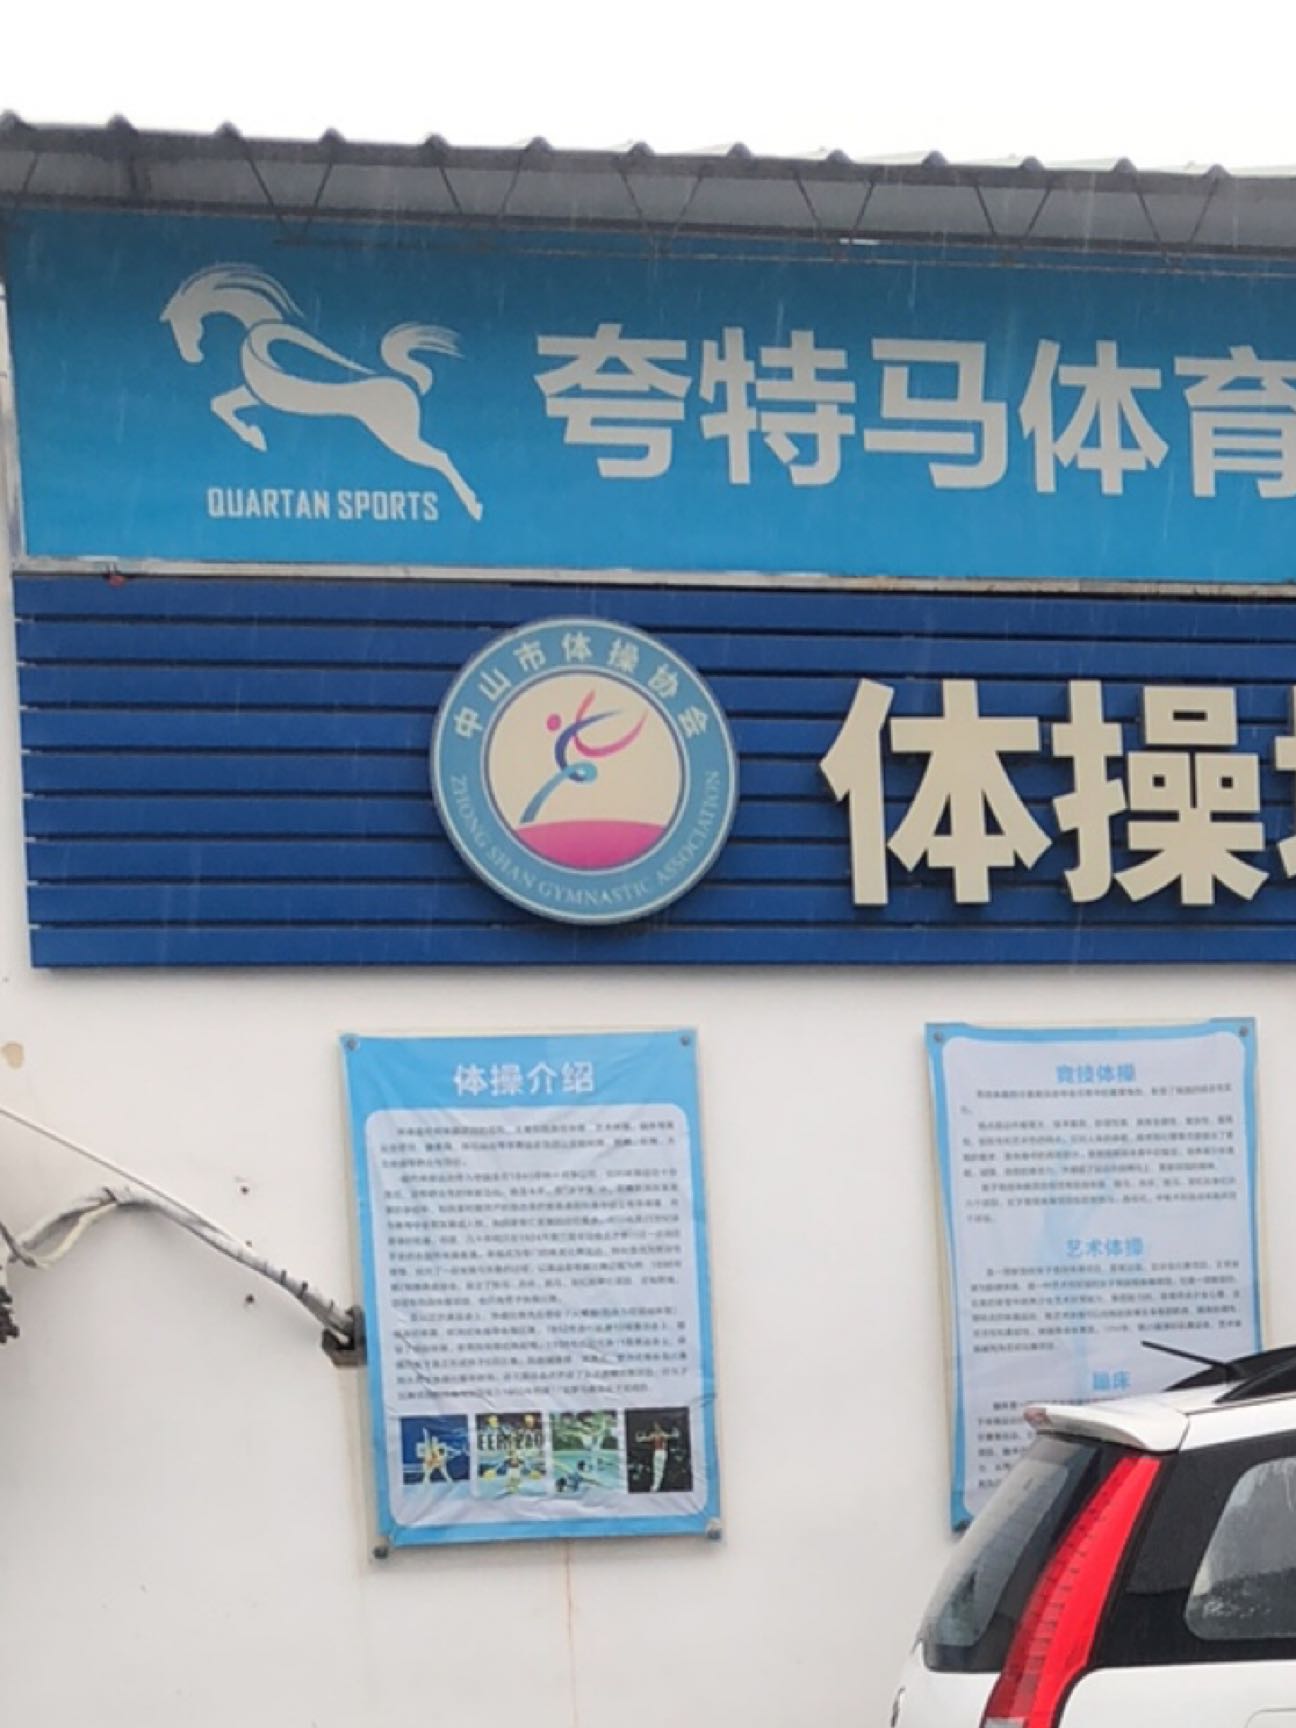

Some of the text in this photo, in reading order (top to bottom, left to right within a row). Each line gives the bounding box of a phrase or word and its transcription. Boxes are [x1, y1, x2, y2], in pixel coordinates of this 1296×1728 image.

[206, 487, 439, 521] QUARTAN SPORTS
[453, 632, 709, 738] 中山市体操协会
[453, 1061, 595, 1097] 体操介绍
